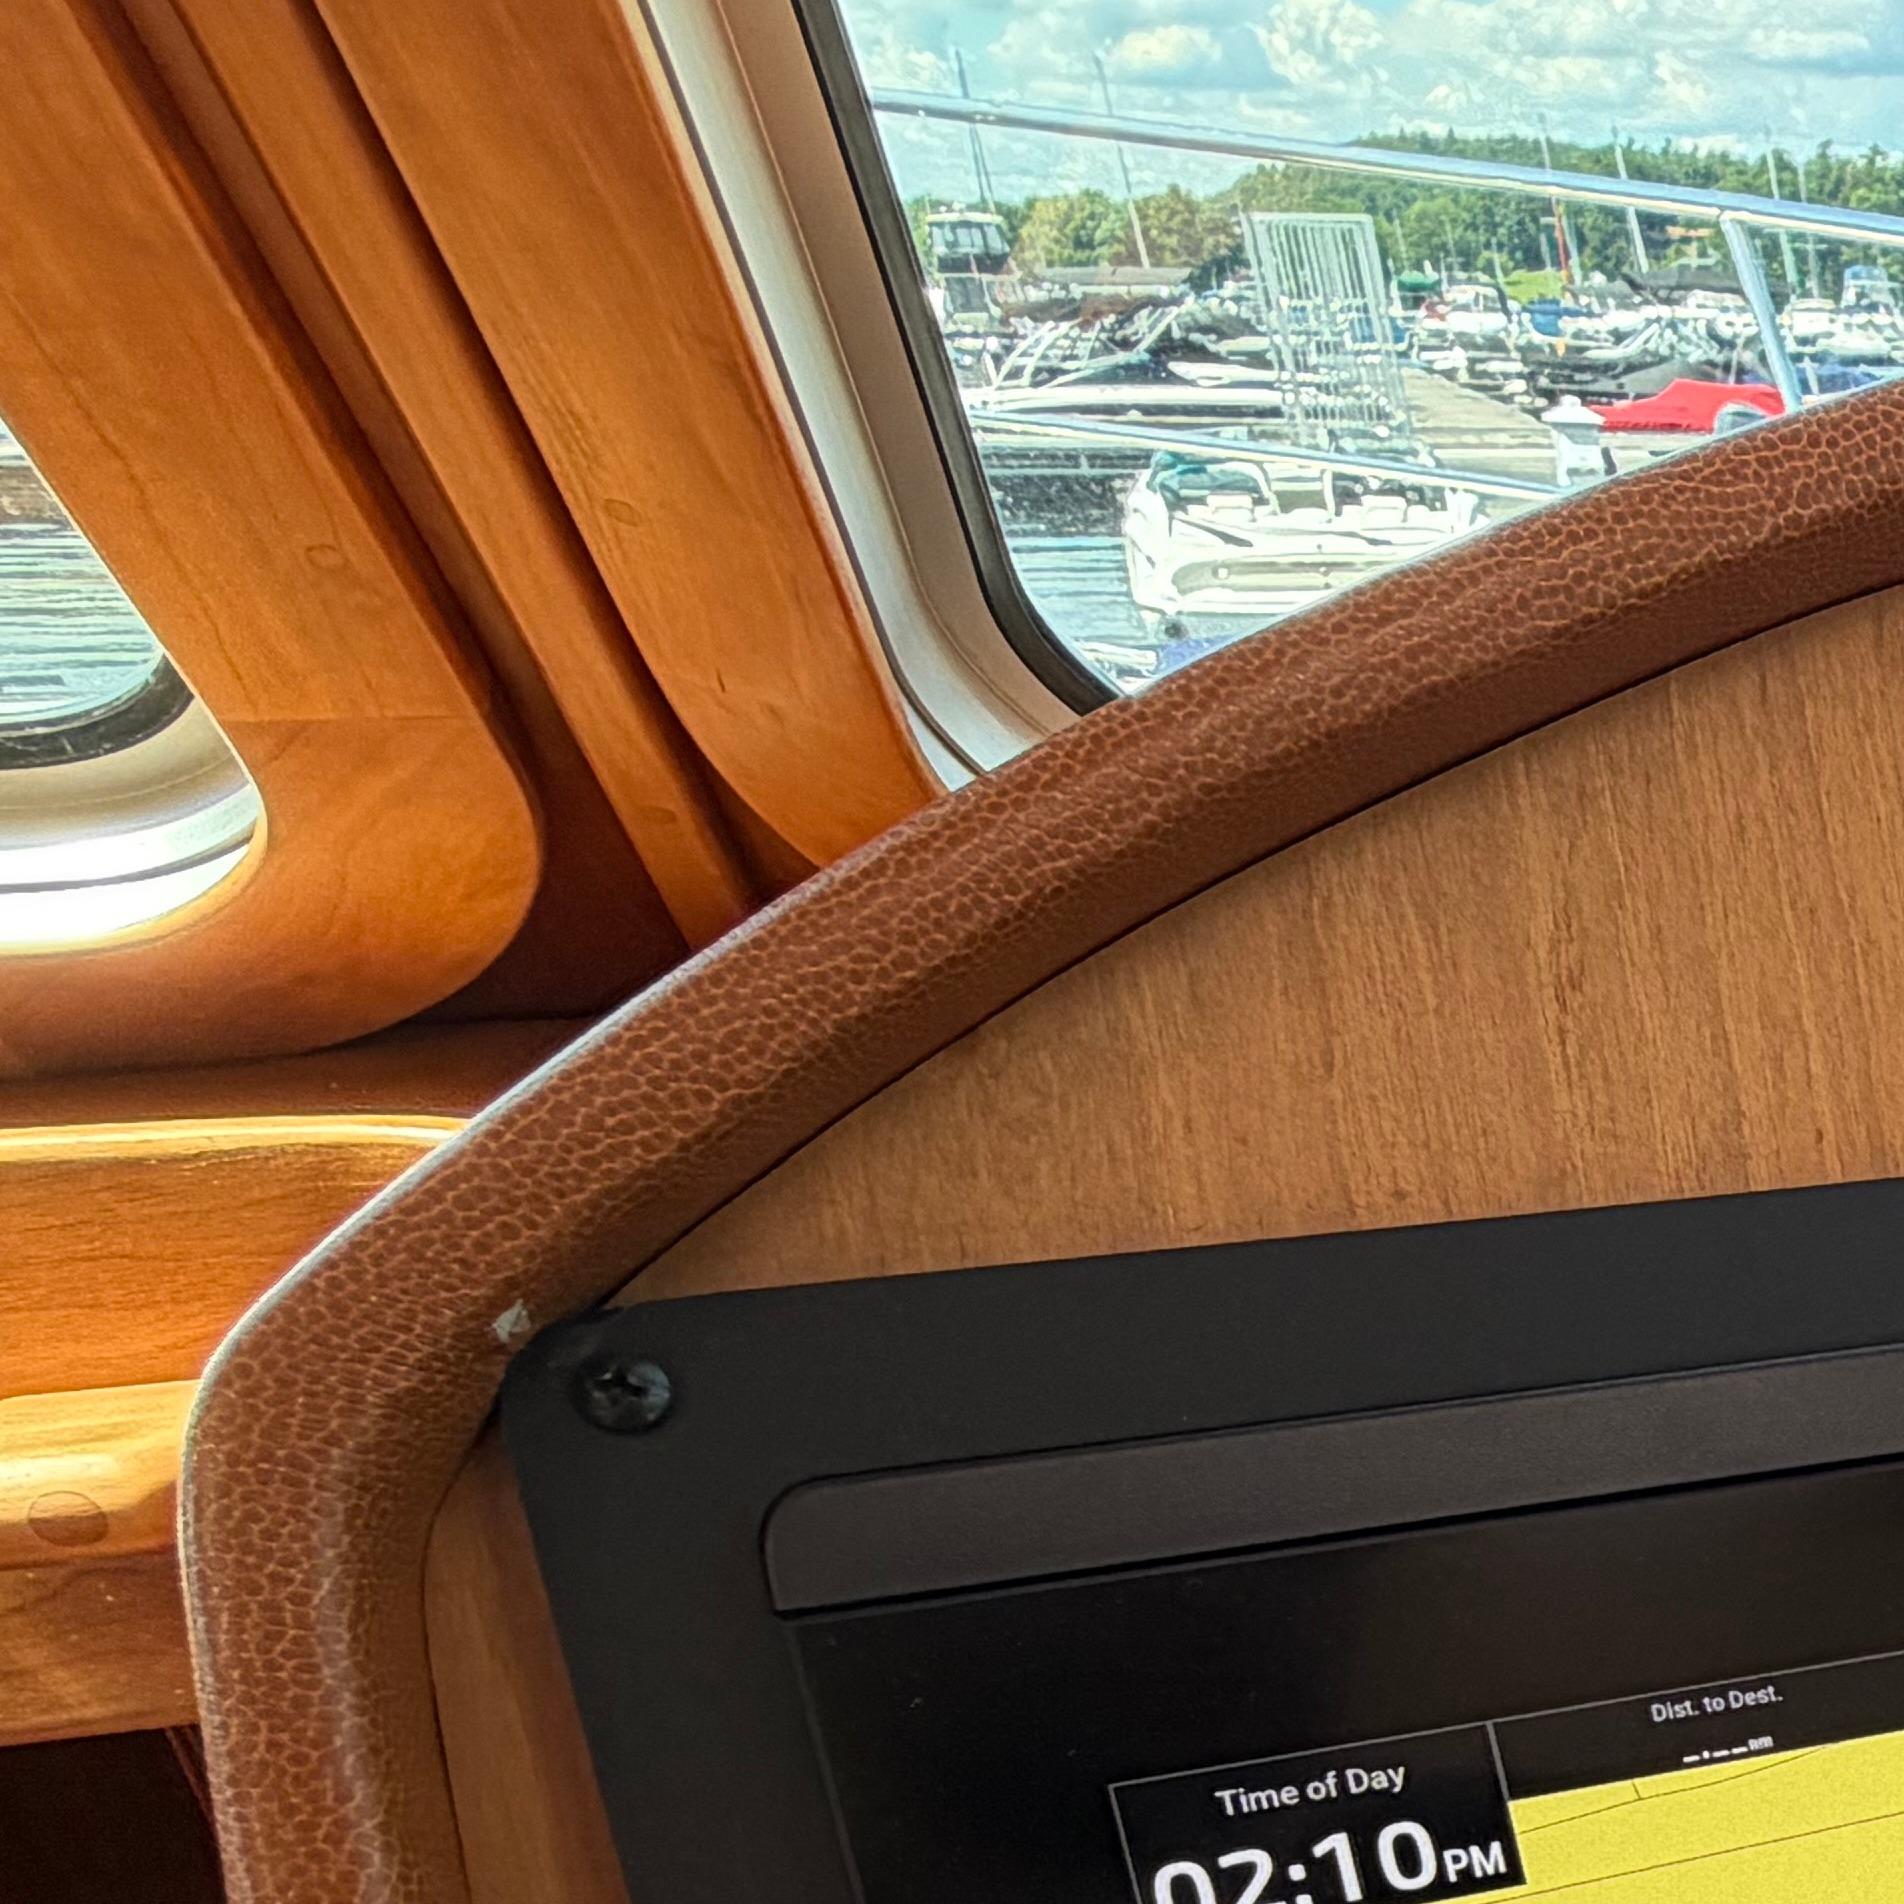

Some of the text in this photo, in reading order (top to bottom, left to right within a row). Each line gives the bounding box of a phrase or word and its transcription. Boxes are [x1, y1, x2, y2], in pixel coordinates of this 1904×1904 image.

[1651, 1685, 1783, 1721] Dist. to Dest.
[1215, 1762, 1406, 1817] Time of Day
